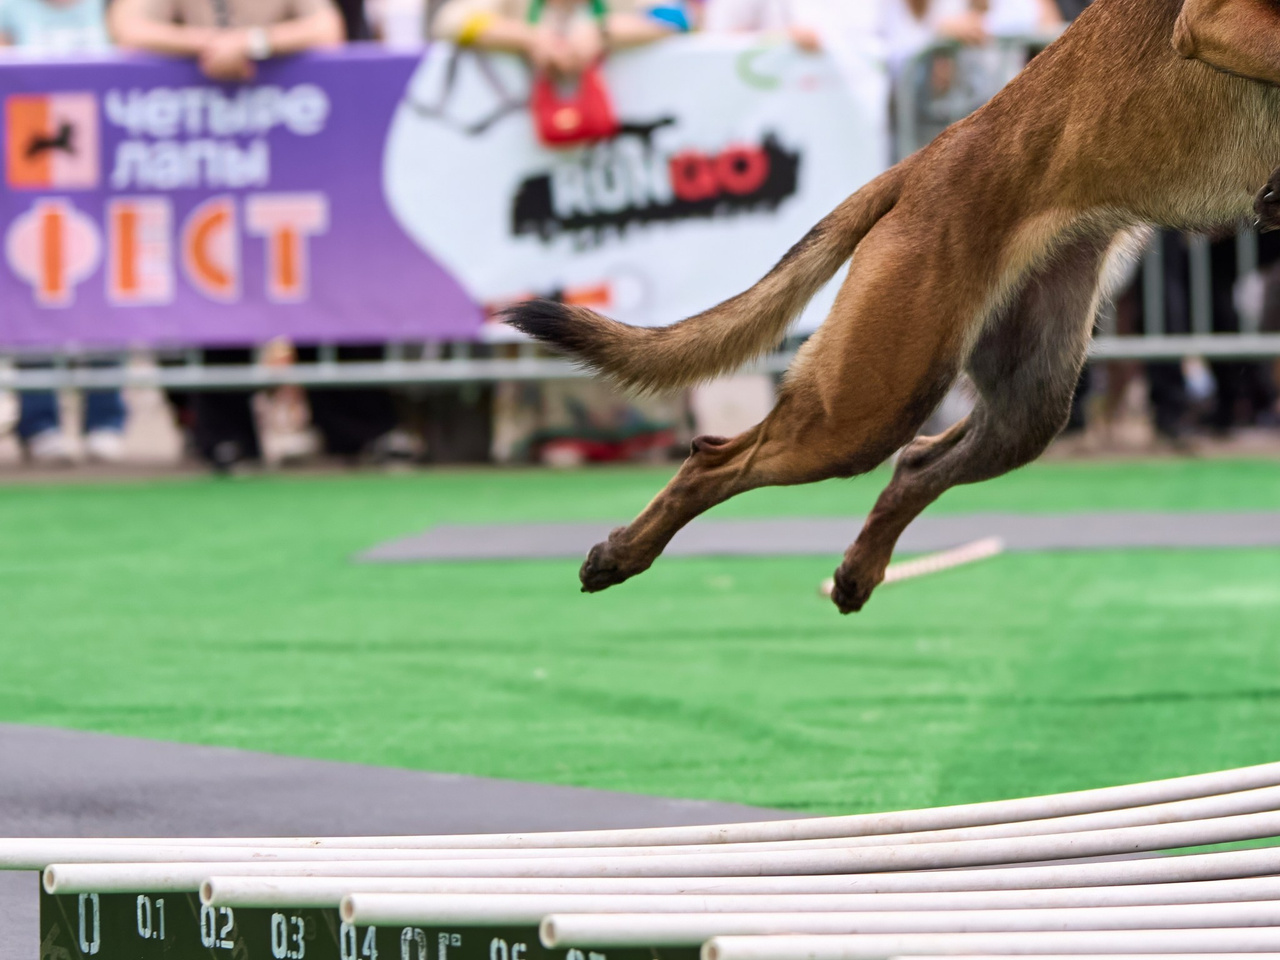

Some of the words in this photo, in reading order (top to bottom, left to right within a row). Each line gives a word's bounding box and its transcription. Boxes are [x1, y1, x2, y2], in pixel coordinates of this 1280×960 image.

[5, 192, 331, 309] ФЕСТ
[79, 892, 100, 955] 0
[137, 894, 165, 940] 0.1
[200, 905, 235, 948] 0.2
[271, 912, 305, 959] 0.3
[339, 921, 378, 960] 04
